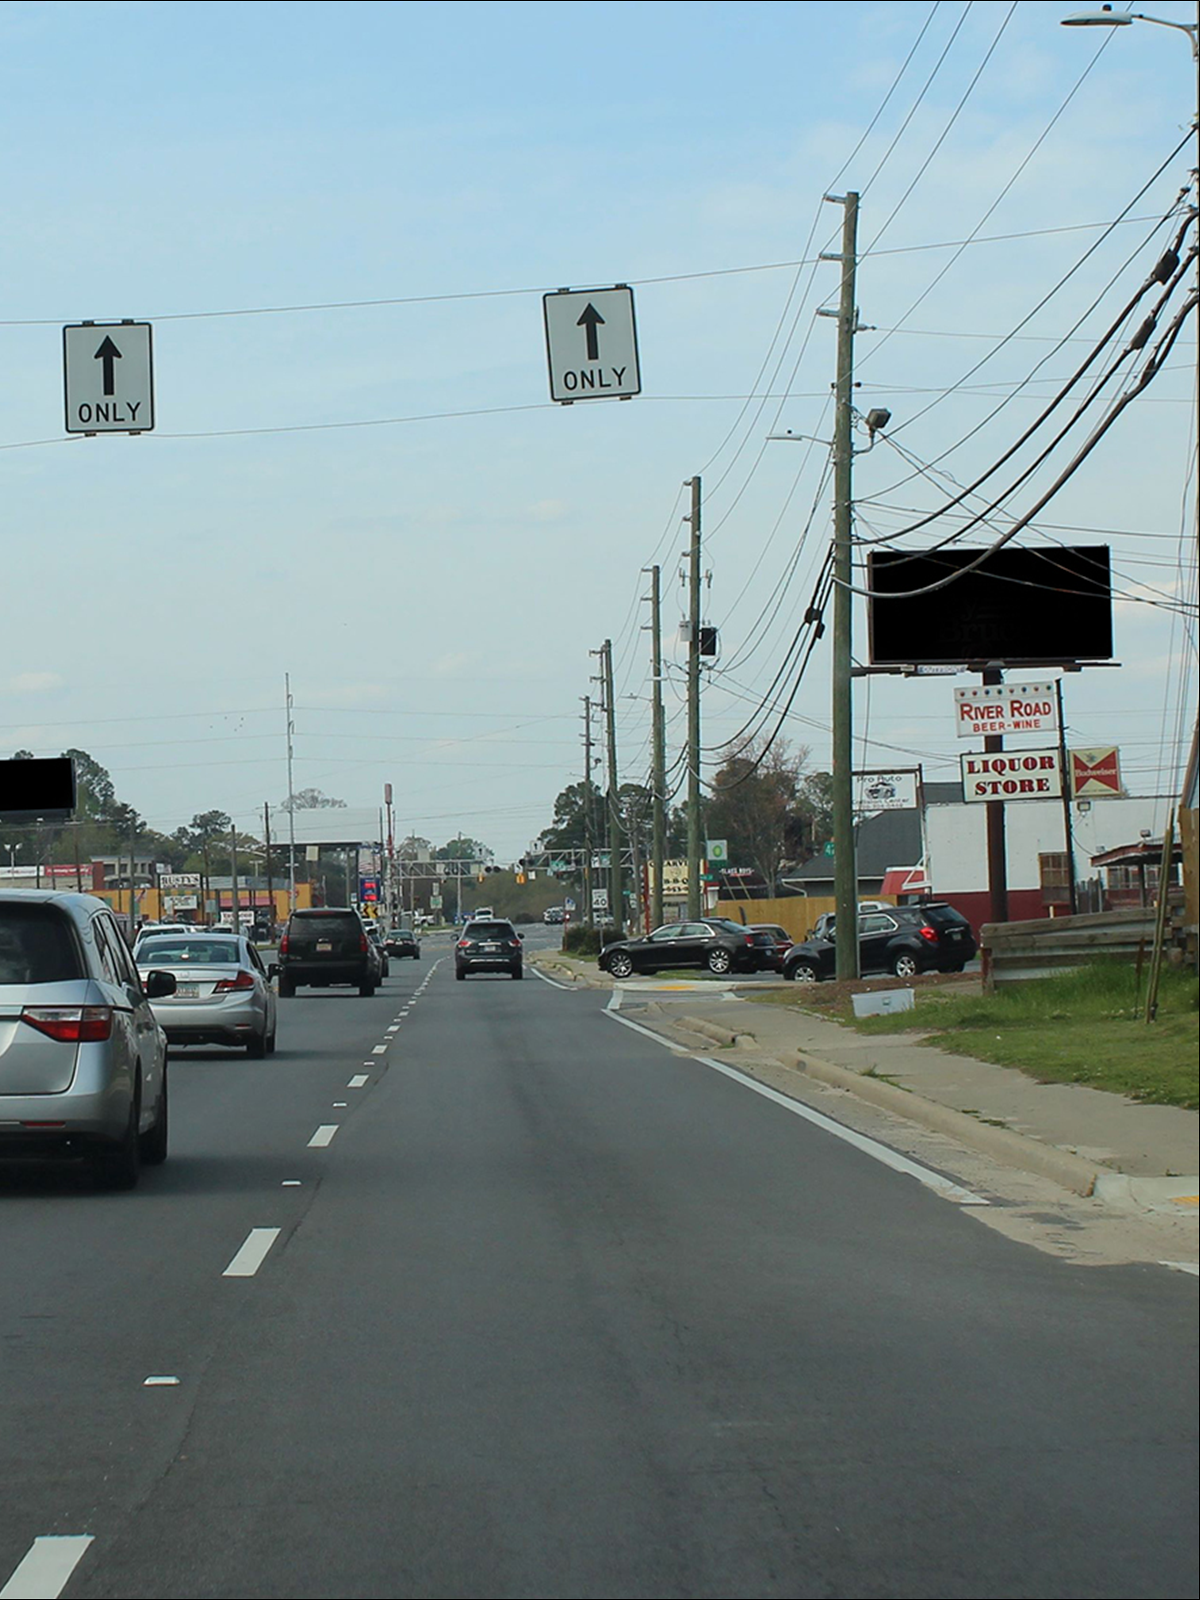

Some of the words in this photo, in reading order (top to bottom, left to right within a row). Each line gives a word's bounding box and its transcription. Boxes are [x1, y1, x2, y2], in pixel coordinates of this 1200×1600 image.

[563, 366, 627, 391] ONLY
[78, 401, 141, 423] ONLY
[960, 703, 1005, 721] RIVER
[1010, 700, 1052, 718] ROAD
[973, 719, 1041, 733] BEER-WINE
[966, 756, 1056, 776] LIQUOR
[975, 778, 1050, 796] STORE
